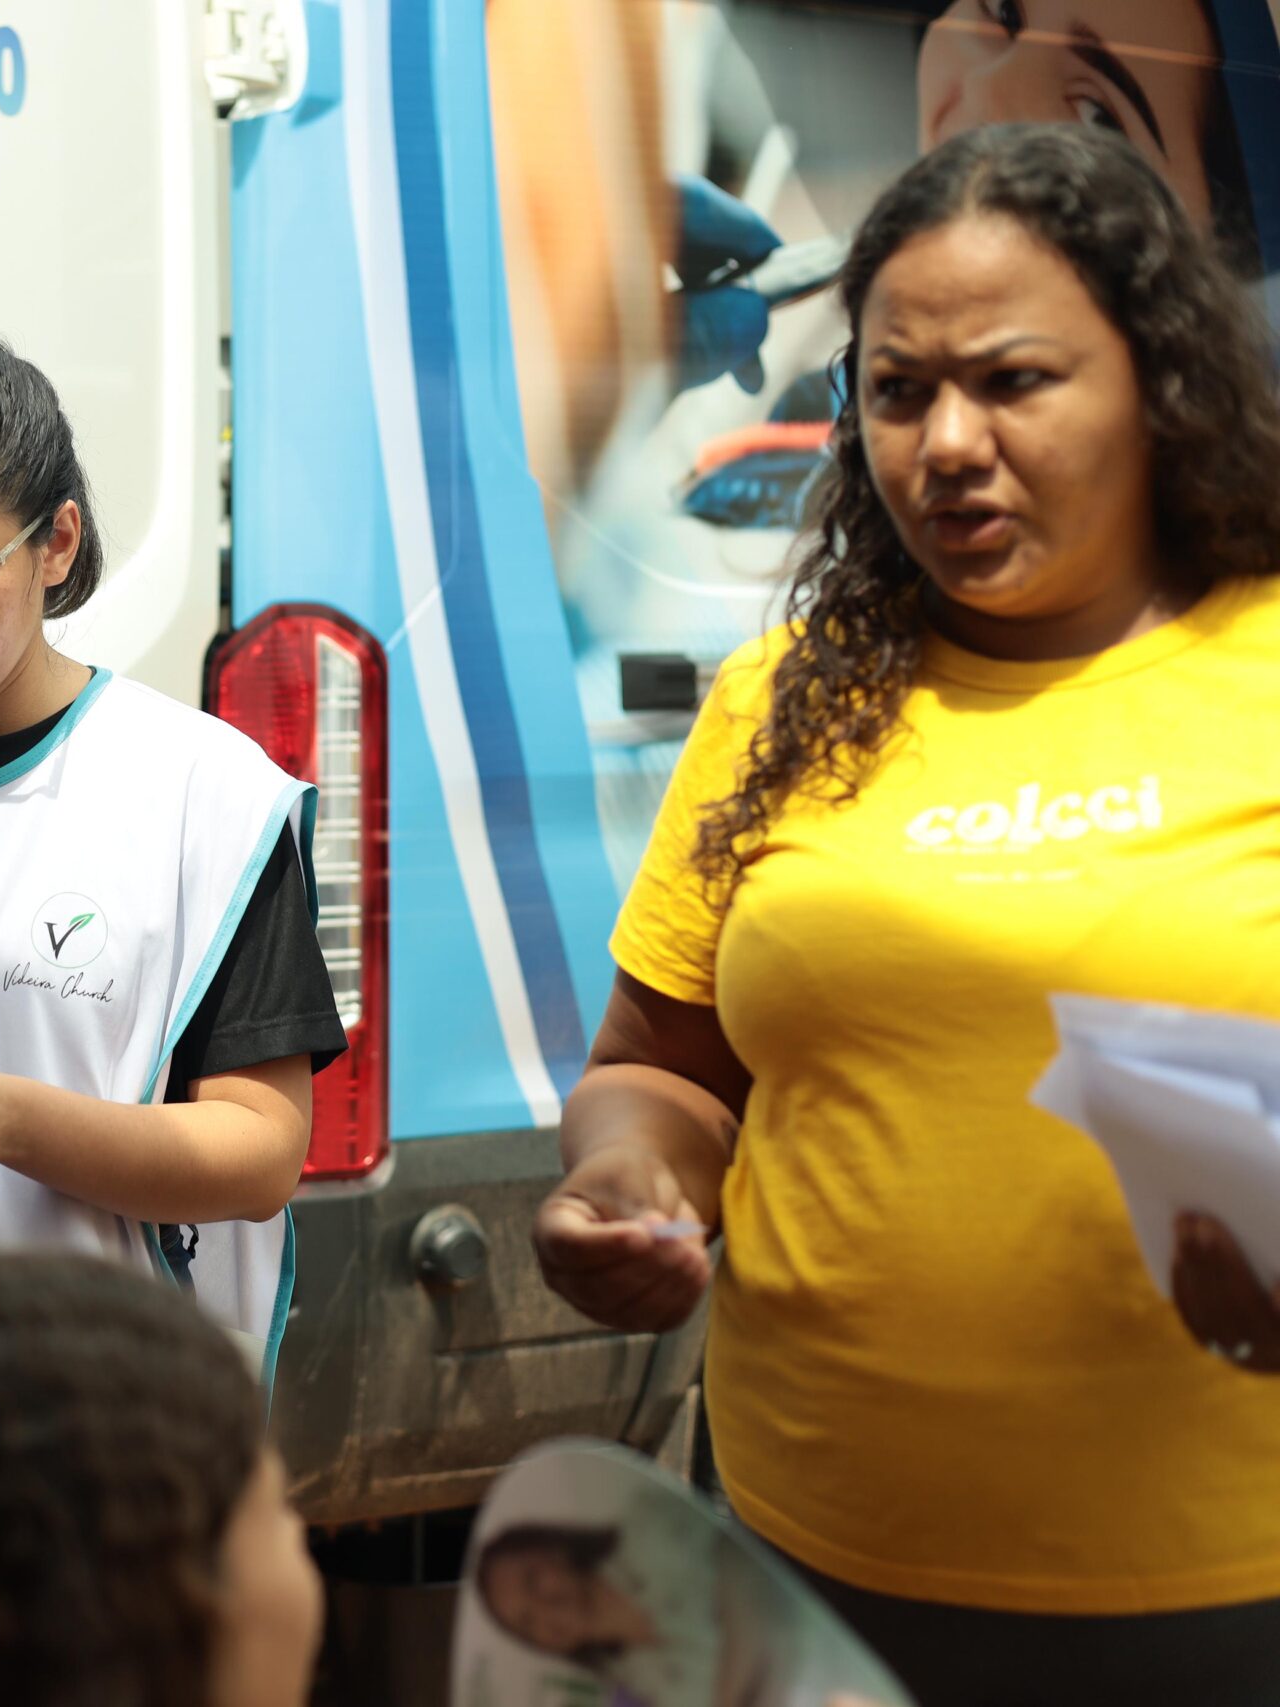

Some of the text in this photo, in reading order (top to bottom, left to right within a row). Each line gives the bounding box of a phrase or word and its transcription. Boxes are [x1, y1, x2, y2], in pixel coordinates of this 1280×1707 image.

[905, 774, 1163, 845] colcci
[3, 961, 114, 1002] Videira Church
